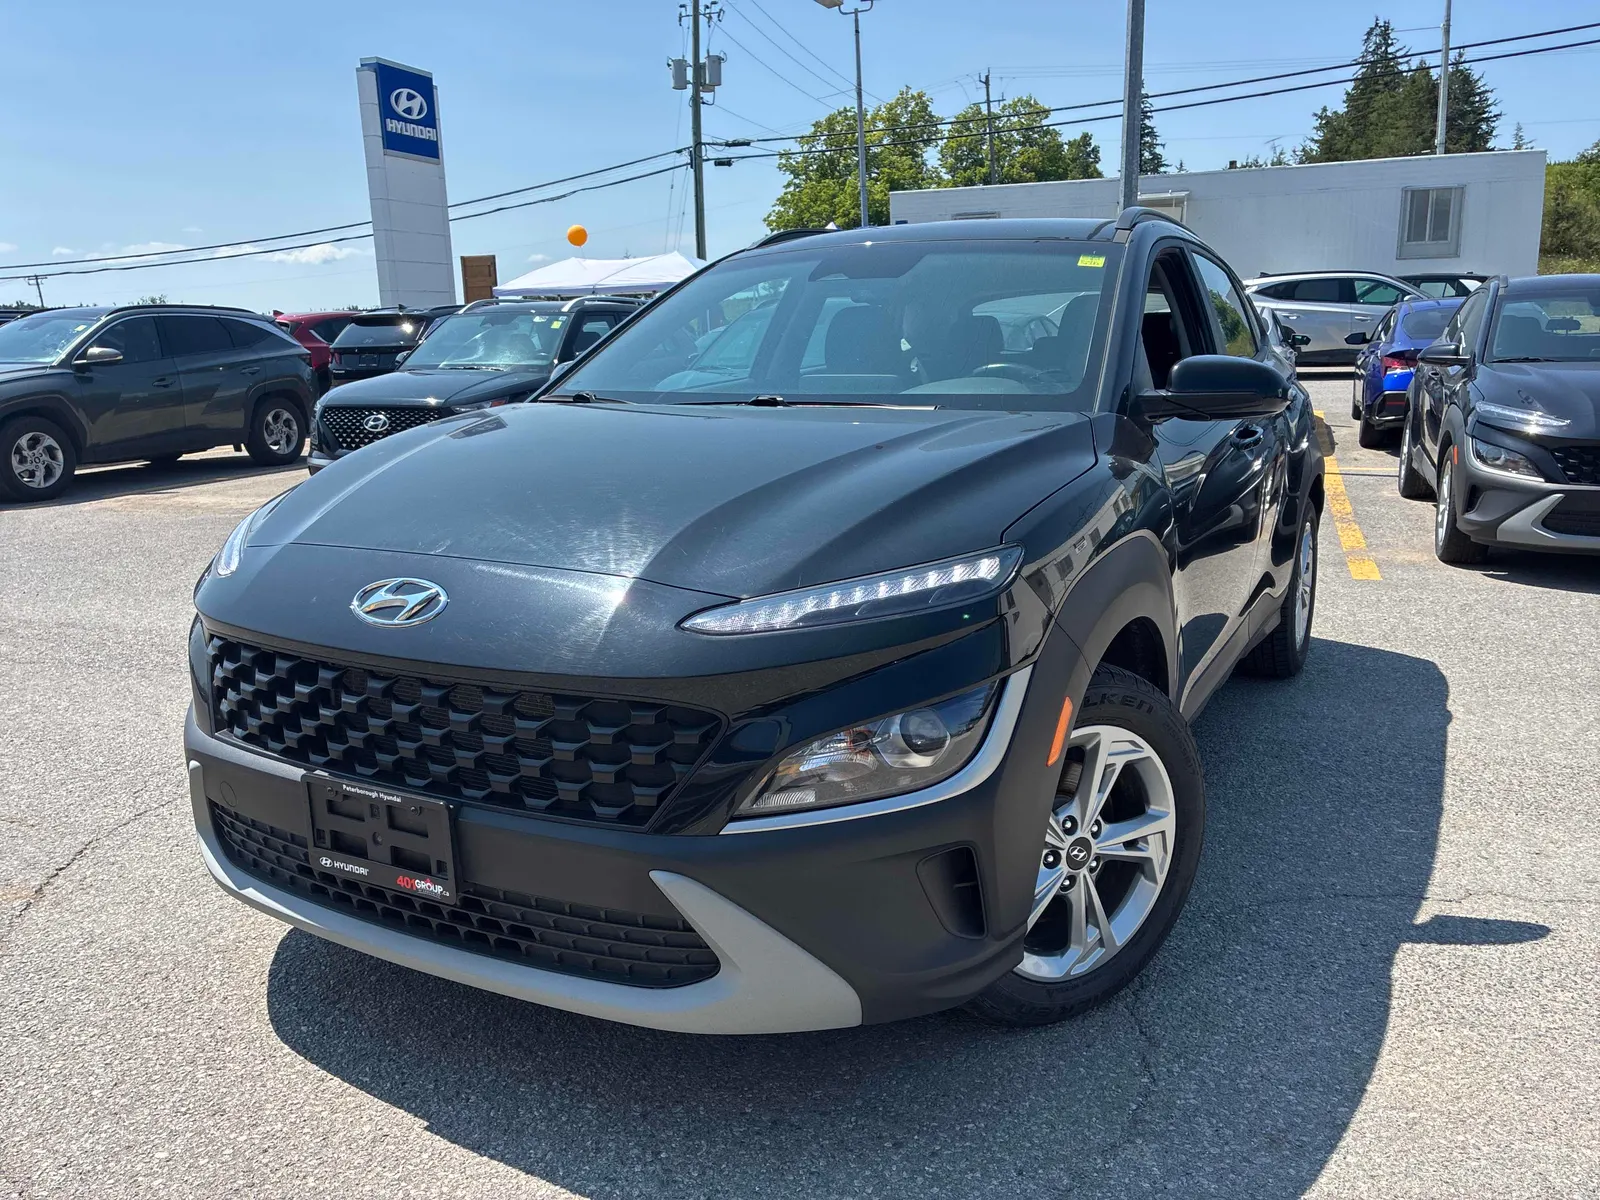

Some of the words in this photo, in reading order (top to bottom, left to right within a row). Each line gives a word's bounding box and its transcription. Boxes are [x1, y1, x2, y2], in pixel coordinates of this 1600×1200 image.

[385, 118, 437, 141] HYUNDAI
[1083, 692, 1154, 714] LKEN
[342, 784, 378, 799] Peterborough
[379, 792, 402, 803] Hyundai
[334, 860, 369, 876] HYUNDAI
